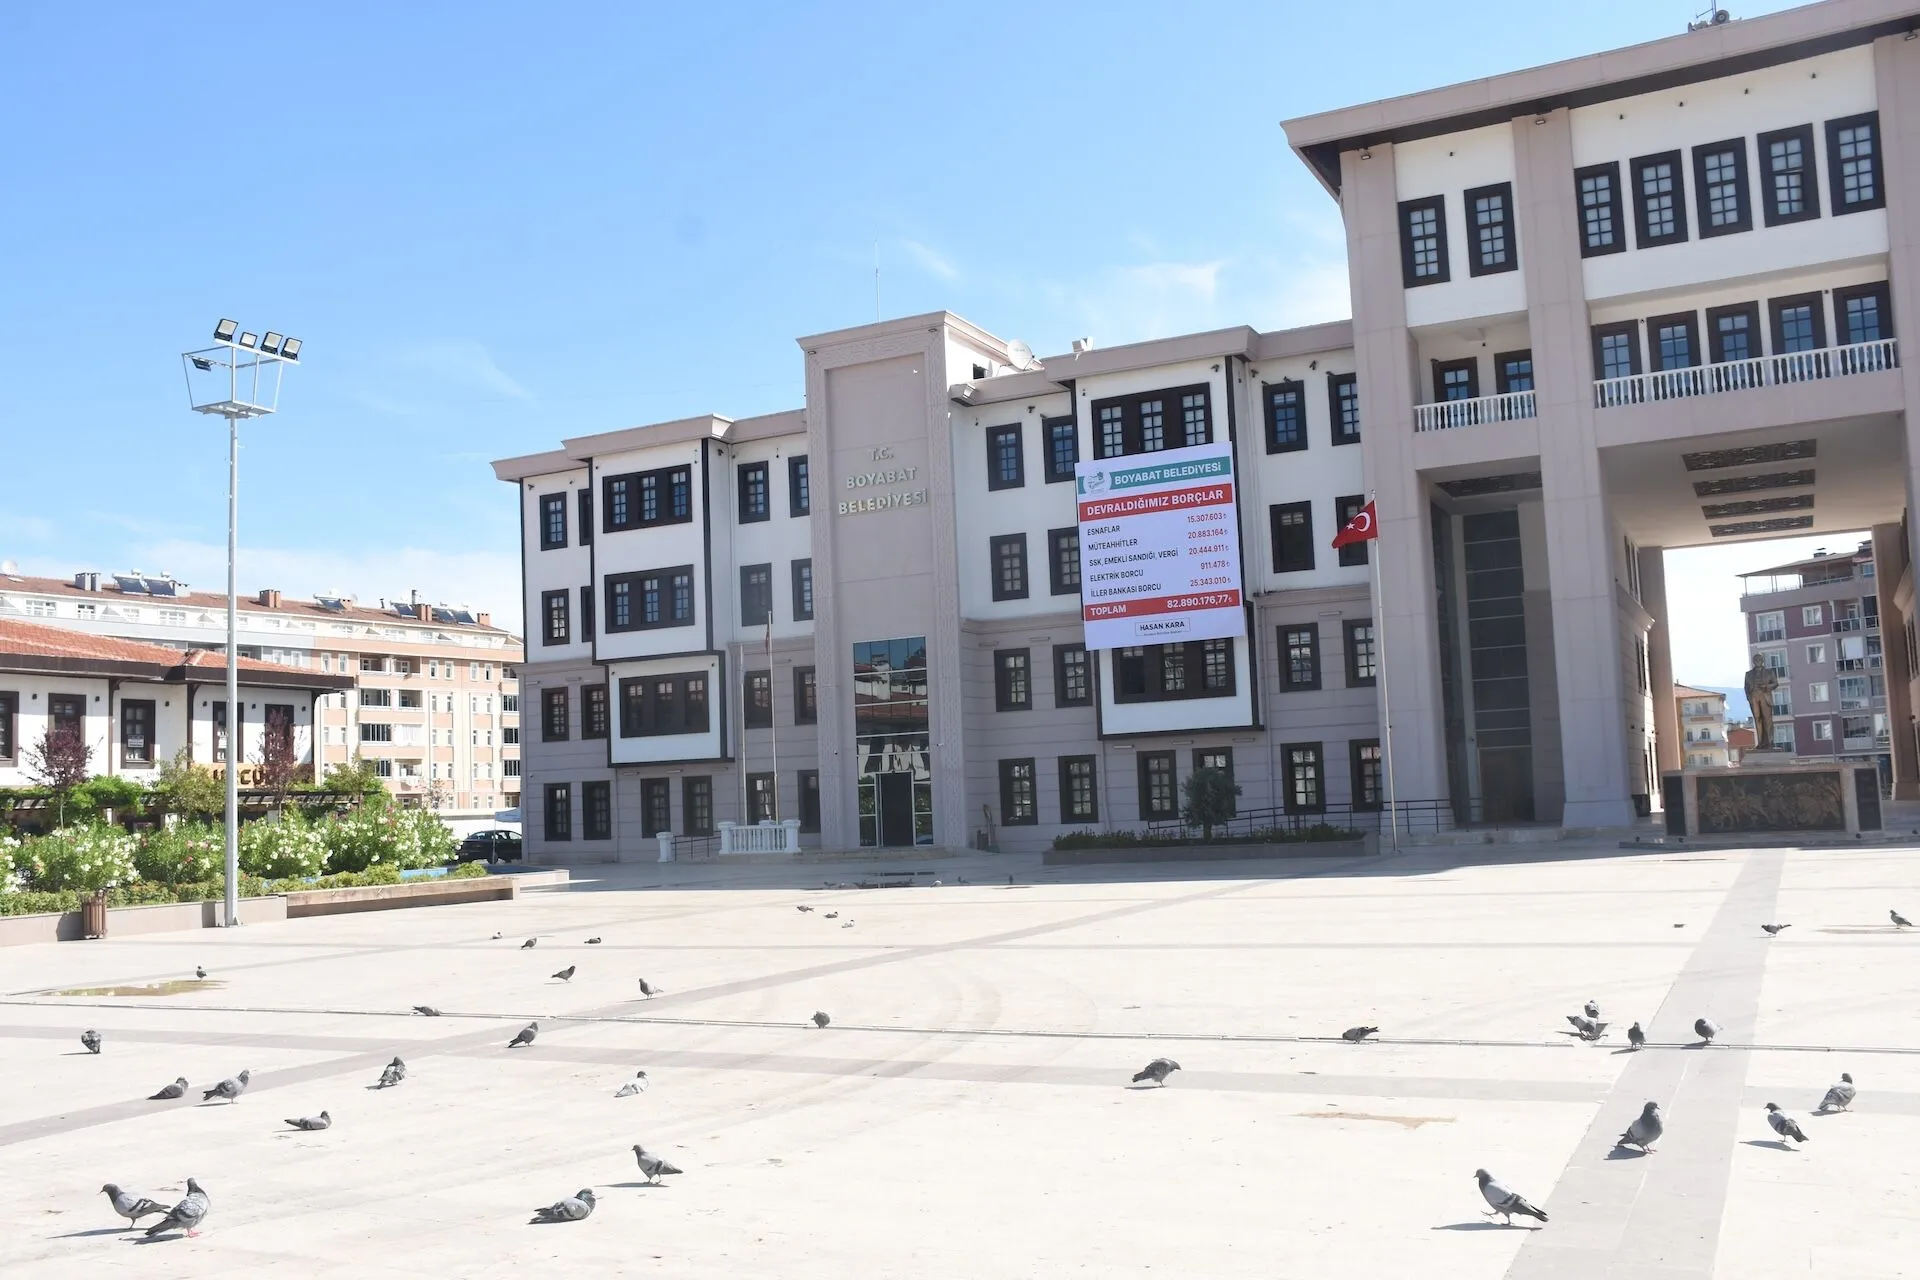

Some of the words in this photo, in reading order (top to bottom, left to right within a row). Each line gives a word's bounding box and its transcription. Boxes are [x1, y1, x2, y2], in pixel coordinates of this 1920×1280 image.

[869, 447, 895, 461] T.C.
[846, 467, 918, 489] BOYABAT
[1114, 470, 1161, 485] BOYABAT
[1163, 462, 1221, 479] BELEDİYESİ
[838, 488, 928, 515] BELEDİYESİ
[1087, 497, 1168, 516] DEVRALDIĞIMIZ
[1171, 489, 1223, 507] BORÇLAR
[1087, 525, 1120, 536] ESNAFLAR
[1088, 538, 1138, 551] MÜTEAHHİTLER
[1158, 547, 1179, 558] VERGİ
[1090, 570, 1120, 582] ELEKTRİK
[1120, 569, 1144, 579] BORCU
[1108, 585, 1138, 596] BANKASI
[1138, 583, 1162, 593] BORCU
[1090, 604, 1127, 616] TOPLAM
[1140, 623, 1164, 631] HASAN
[1165, 621, 1185, 629] KARA
